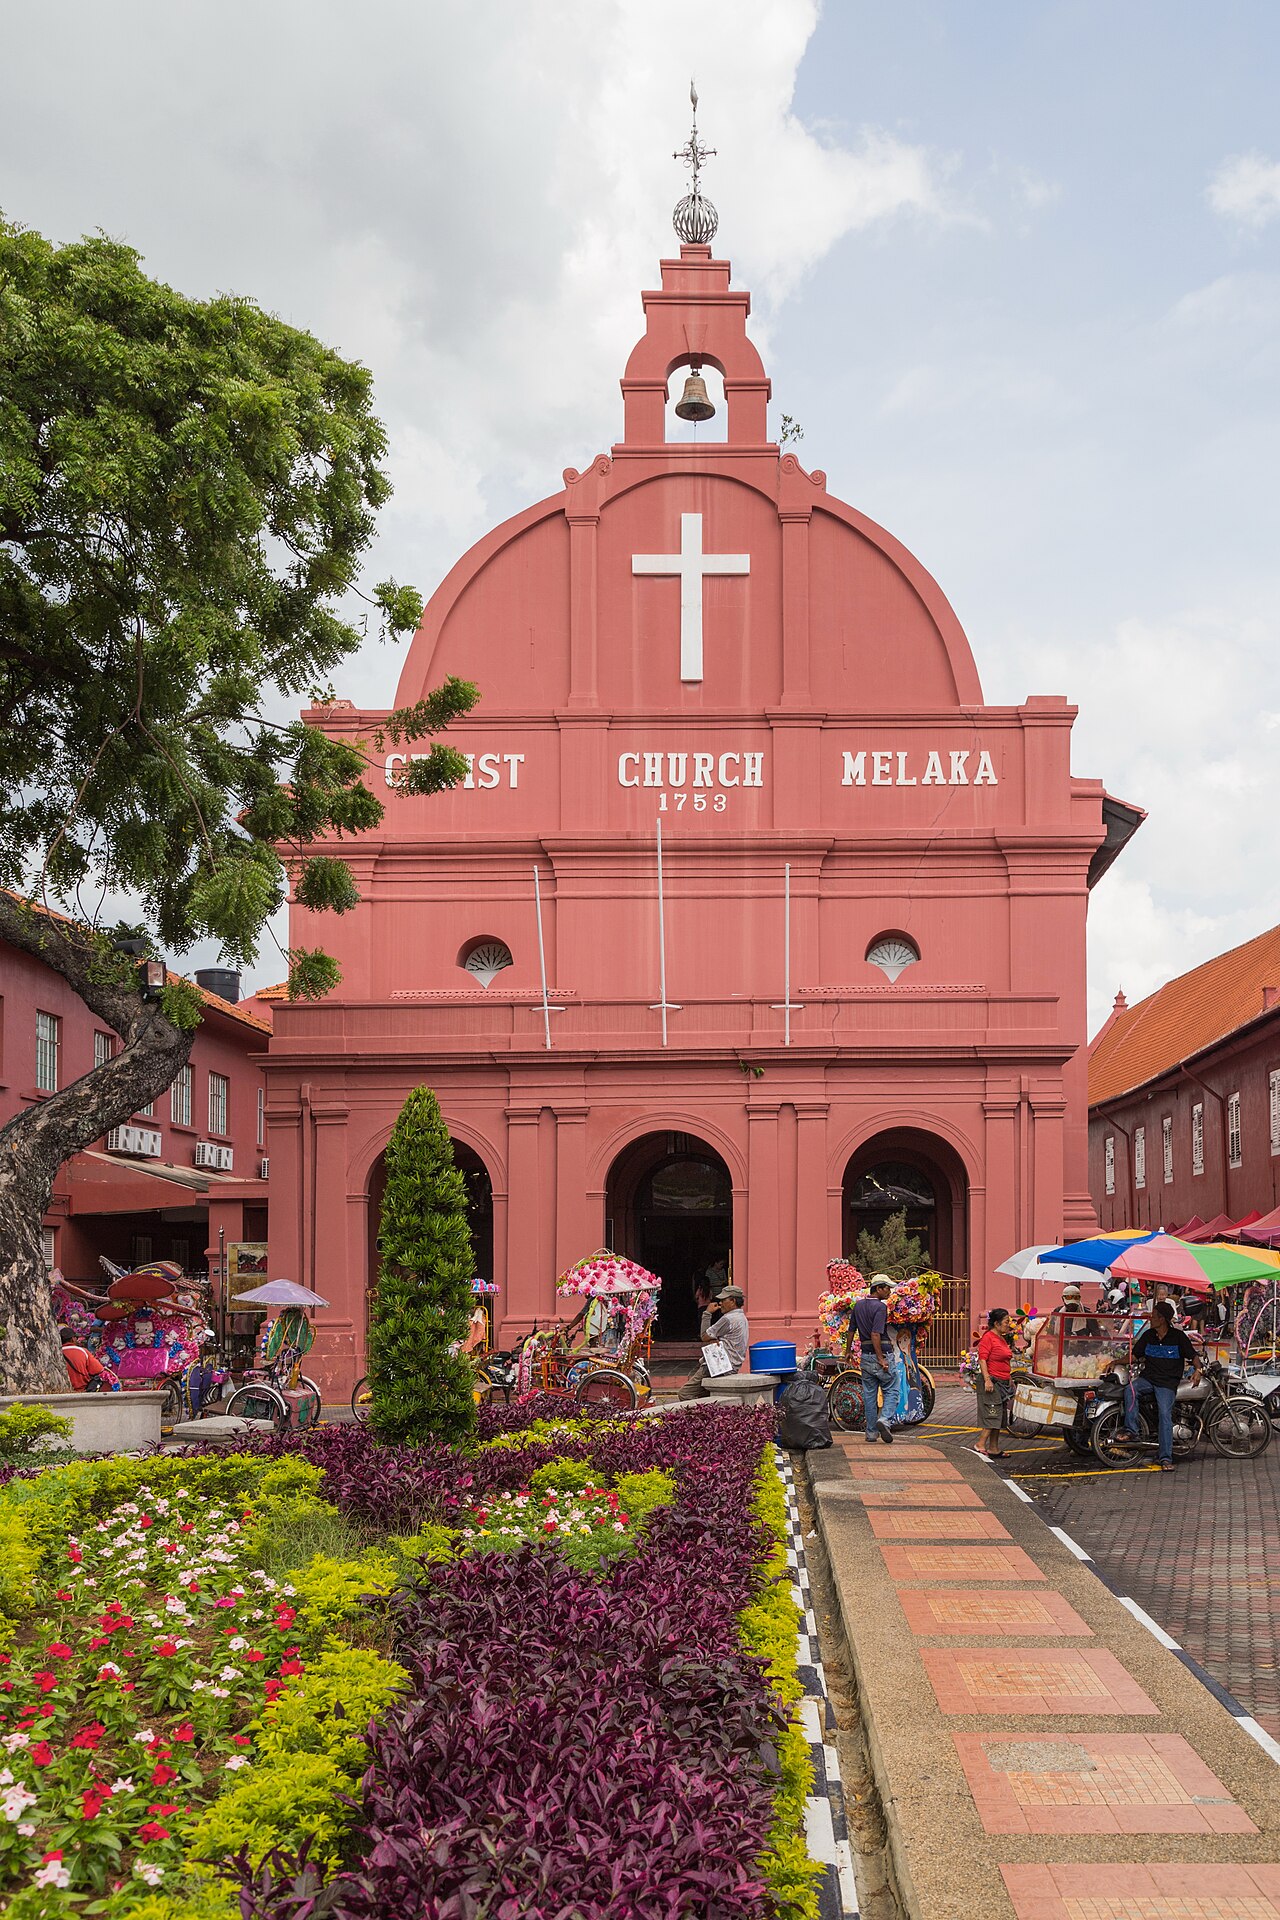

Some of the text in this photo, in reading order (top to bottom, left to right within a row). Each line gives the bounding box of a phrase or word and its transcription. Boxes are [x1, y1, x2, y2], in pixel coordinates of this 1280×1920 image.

[384, 750, 999, 789] CIST CHURCH MELAKA
[659, 793, 727, 812] 1753
